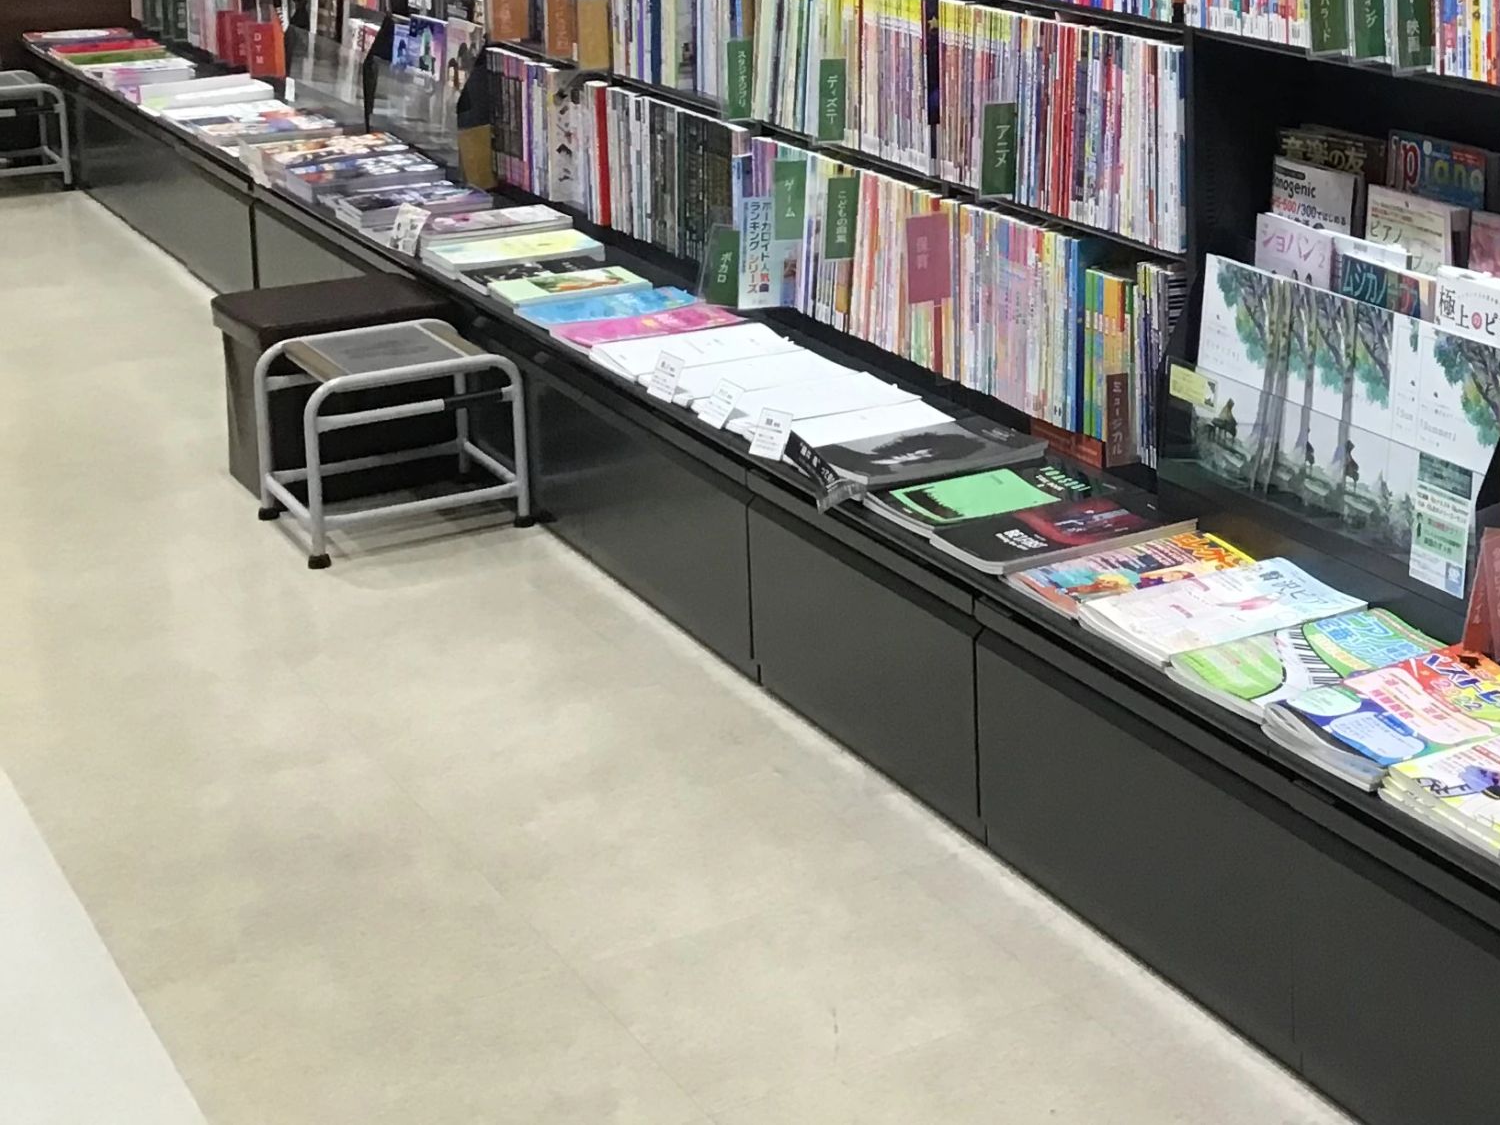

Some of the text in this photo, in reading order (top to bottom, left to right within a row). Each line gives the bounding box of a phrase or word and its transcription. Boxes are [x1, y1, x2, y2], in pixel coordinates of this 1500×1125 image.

[253, 32, 264, 66] DTM
[736, 50, 749, 108] スタジオジブリ
[826, 75, 839, 125] ディズニー
[995, 125, 1010, 169] アニメ
[1281, 135, 1367, 173] 音楽の友
[783, 179, 797, 219] ゲーム
[835, 189, 847, 244] こどもの曲集
[748, 200, 761, 252] ランキング
[715, 250, 732, 285] ボカロ
[1109, 380, 1124, 456] ミュージカル
